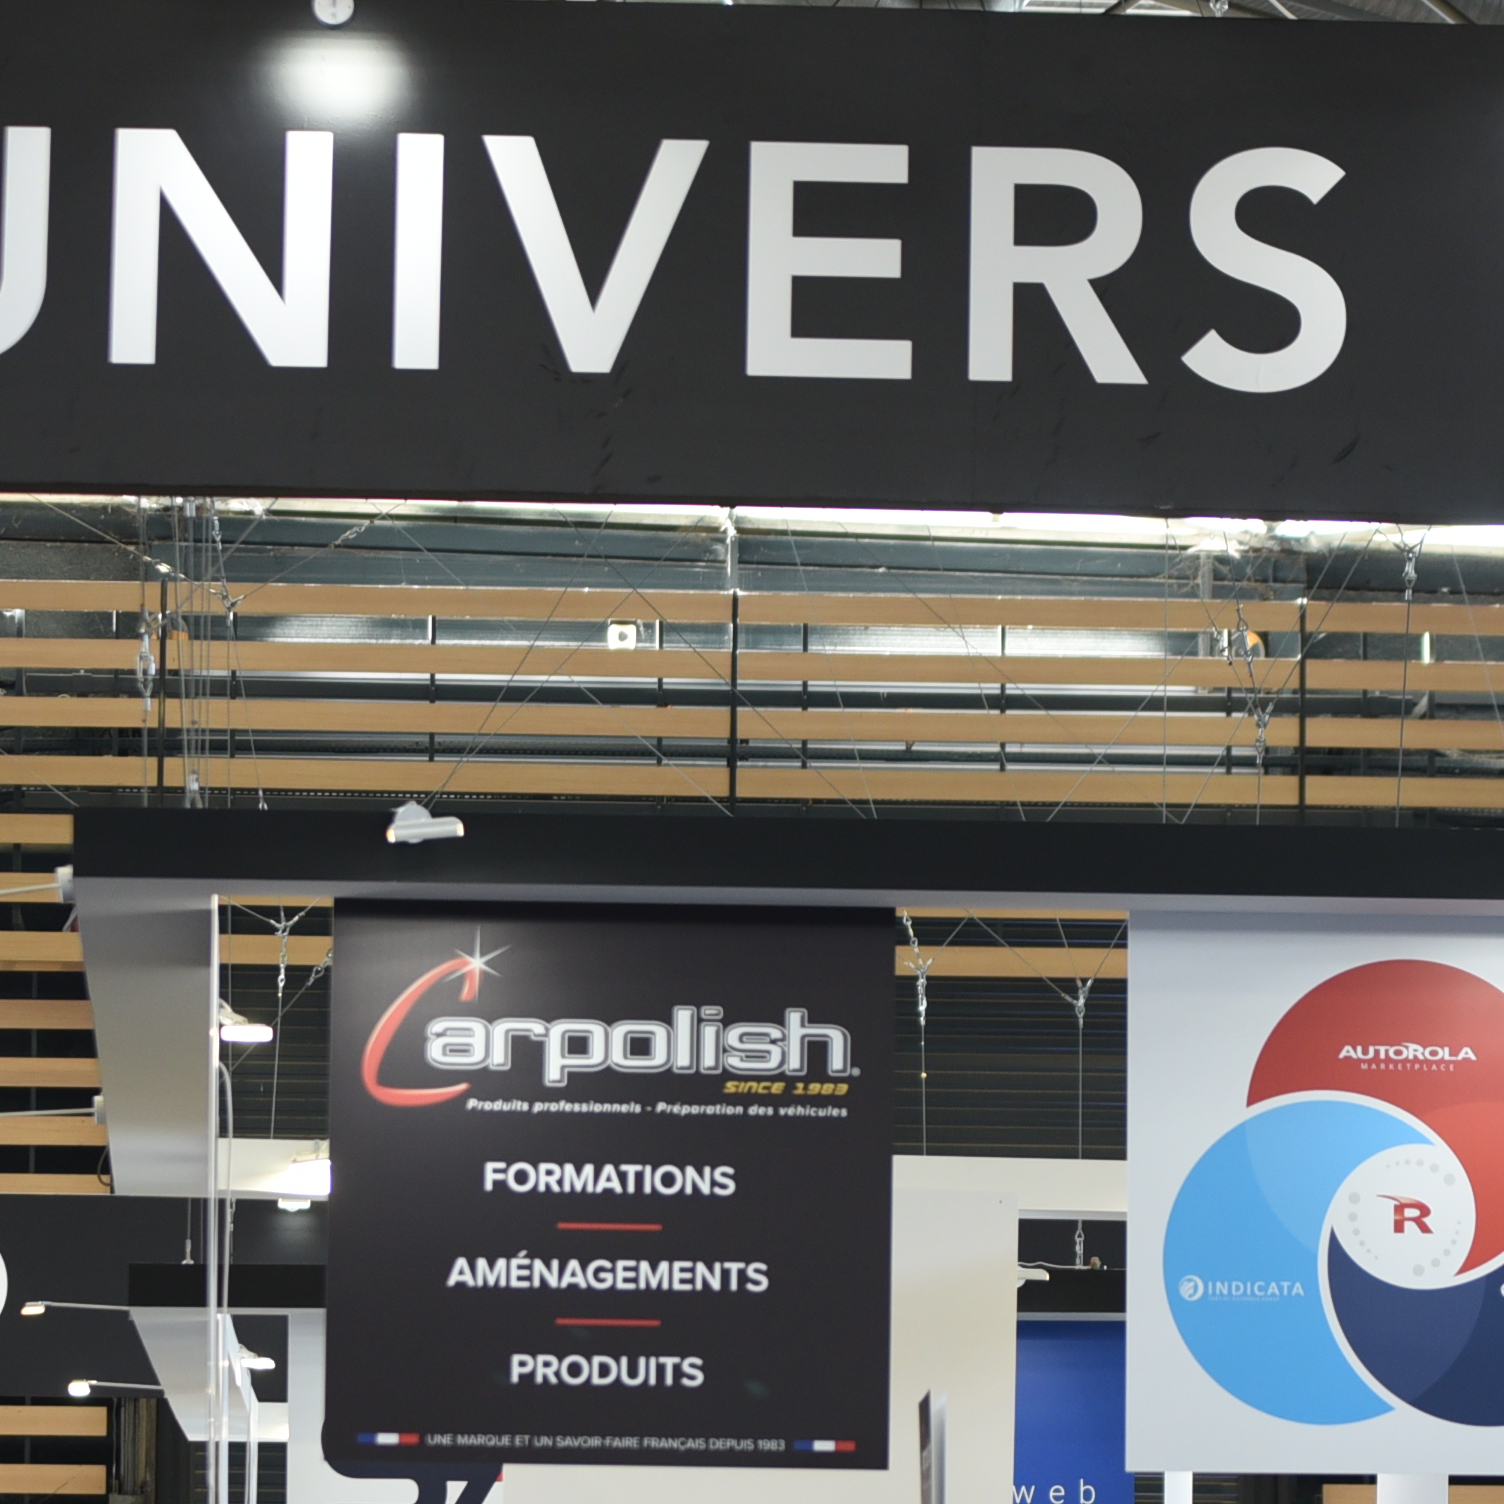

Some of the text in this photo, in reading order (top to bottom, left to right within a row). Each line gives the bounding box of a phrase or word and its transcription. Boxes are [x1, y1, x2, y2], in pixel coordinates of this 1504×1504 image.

[361, 956, 852, 1107] Carpolish
[1338, 1042, 1478, 1061] AUTOROLA
[1360, 1063, 1456, 1072] MARKETPLACE
[723, 1080, 849, 1096] SINCE 1983
[466, 1098, 529, 1112] Produits
[533, 1099, 642, 1115] professionnels
[655, 1101, 743, 1117] Préparation
[748, 1103, 774, 1116] des
[779, 1104, 848, 1118] véhicules
[483, 1161, 737, 1196] FORMATIONS
[446, 1250, 769, 1292] AMÉNAGEMENTS
[1207, 1280, 1305, 1297] INDICATA
[509, 1353, 704, 1387] PRODUITS
[427, 1433, 454, 1446] UNE
[456, 1433, 512, 1447] MARQUE
[515, 1434, 531, 1446] ET
[535, 1434, 553, 1447] UN
[644, 1436, 706, 1451] FRANÇAIS
[709, 1437, 754, 1450] DEPUIS
[757, 1438, 786, 1451] 1983
[1012, 1478, 1096, 1504] web
